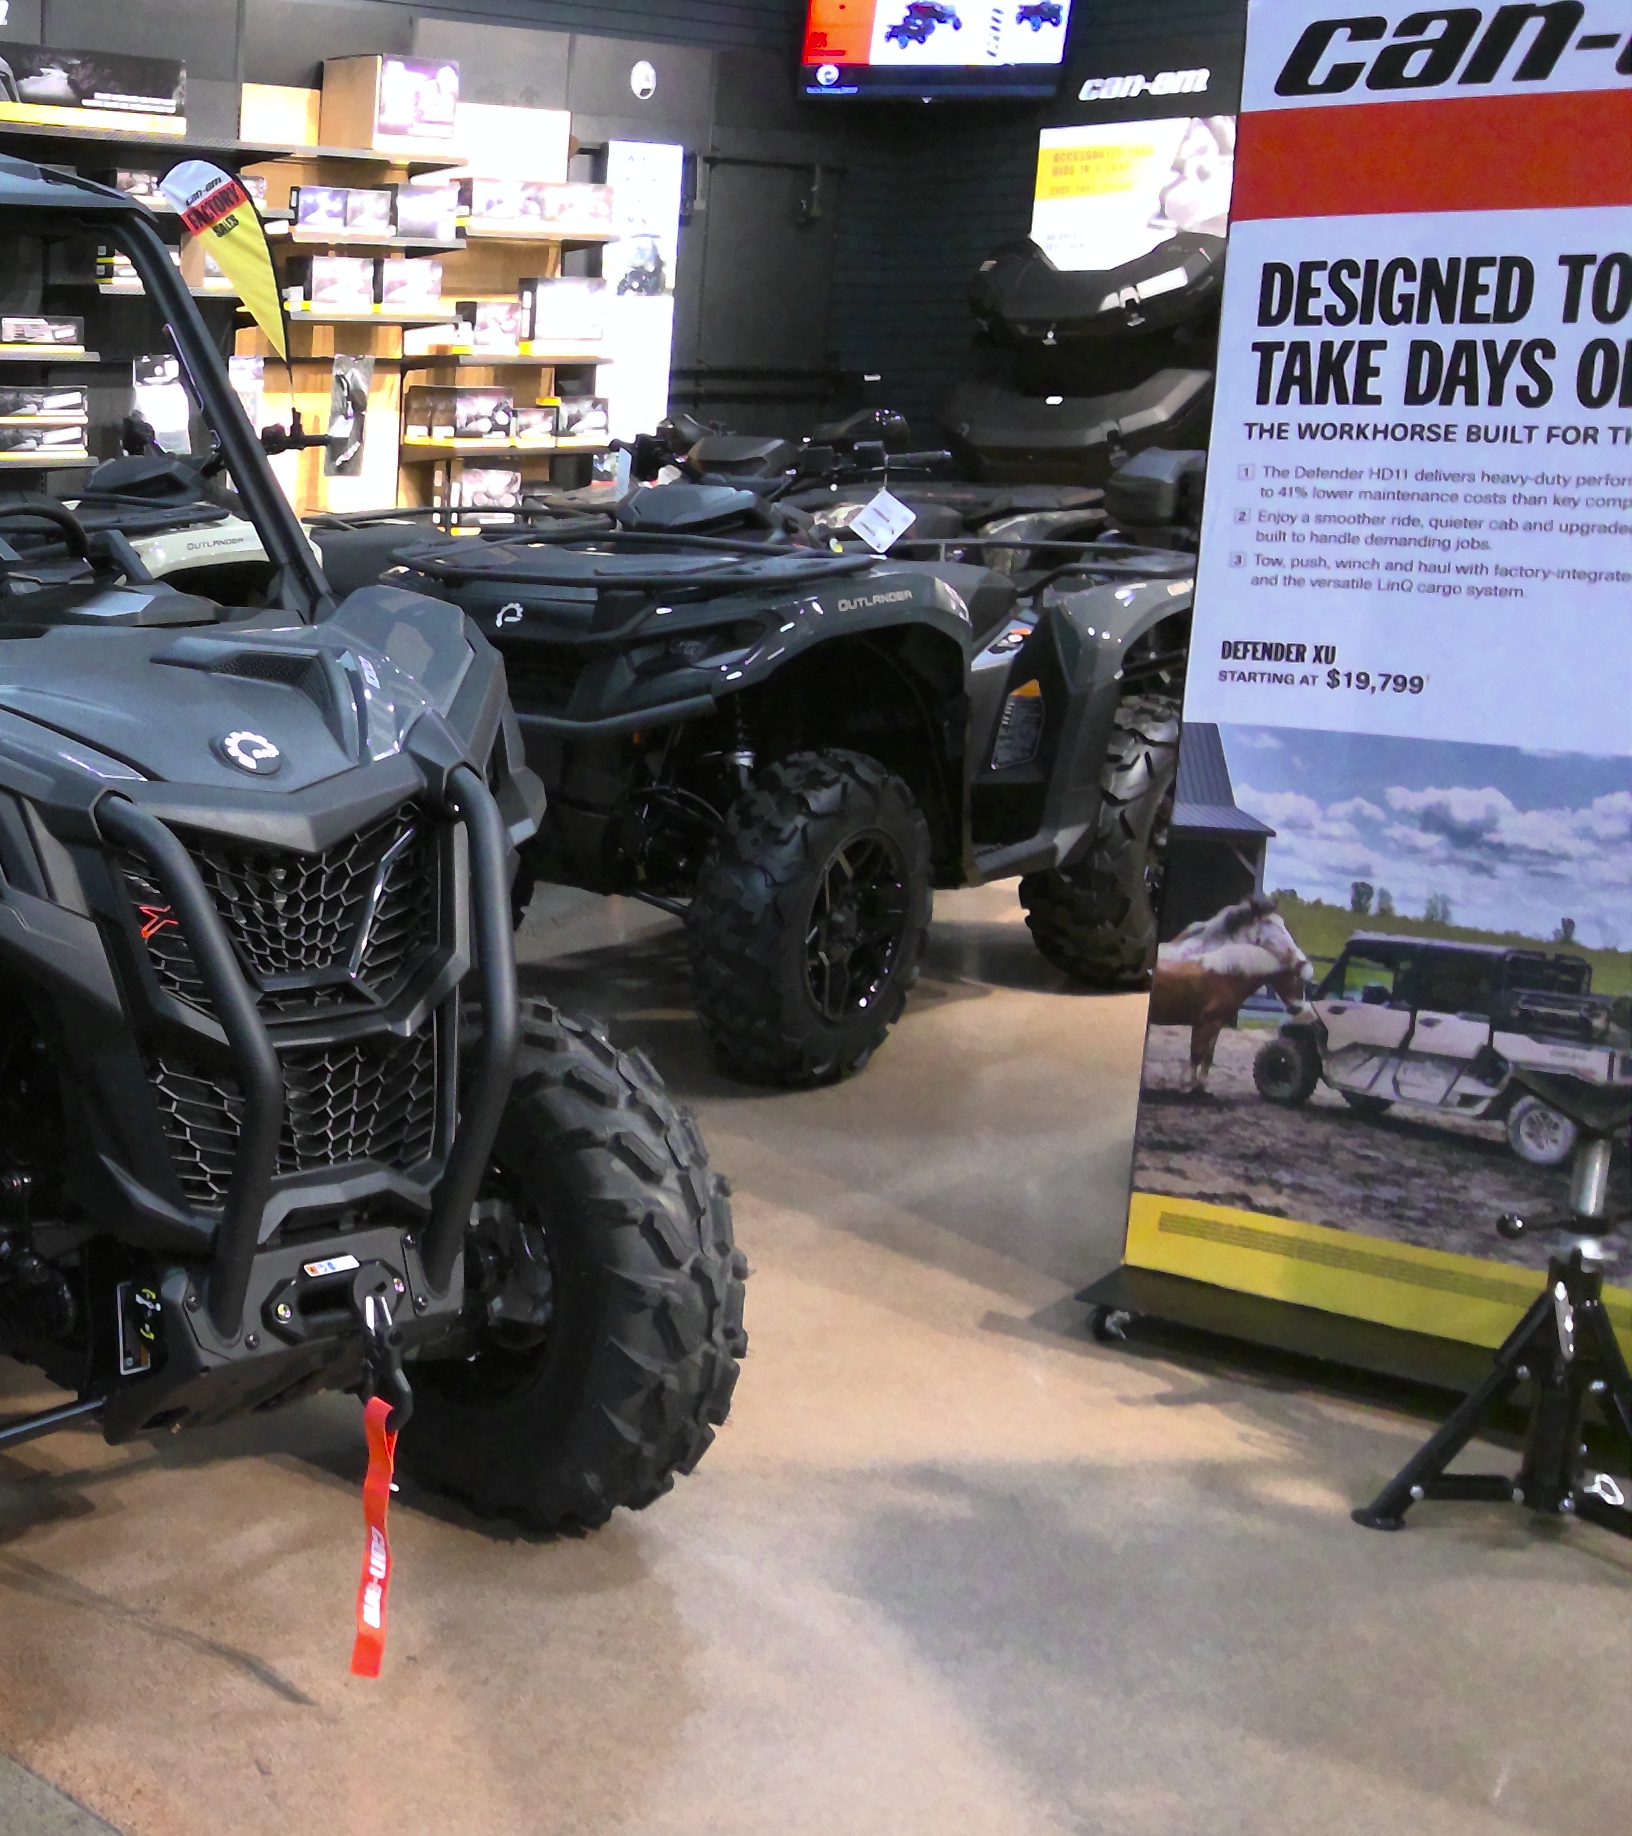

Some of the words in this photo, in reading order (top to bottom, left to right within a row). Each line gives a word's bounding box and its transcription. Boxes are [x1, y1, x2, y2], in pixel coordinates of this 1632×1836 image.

[1274, 1, 1632, 96] can-
[1079, 67, 1210, 102] can-am
[187, 183, 241, 231] FACTORY
[1257, 255, 1535, 327] DESIGNED
[1558, 252, 1632, 325] TO
[1251, 339, 1388, 406] TAKE
[1403, 337, 1556, 409] DAYS
[1244, 422, 1290, 441] THE
[1298, 423, 1458, 443] WORKHORSE
[1465, 424, 1539, 445] BUILT
[1546, 425, 1600, 446] FOR
[1263, 465, 1290, 479] The
[1294, 466, 1364, 480] Defender
[1368, 467, 1409, 480] HD11
[1414, 469, 1476, 482] delivers
[1480, 471, 1572, 487] heavy-duty
[1575, 472, 1632, 488] perfor
[1260, 486, 1274, 498] to
[1278, 486, 1308, 498] 41%
[1312, 486, 1354, 499] lower
[1358, 488, 1459, 503] maintenance
[1463, 492, 1507, 505] costs
[1512, 492, 1548, 506] than
[1552, 494, 1581, 510] key
[1257, 510, 1298, 526] Enjoy
[1301, 513, 1310, 524] a
[1314, 513, 1387, 525] smoother
[1391, 515, 1424, 529] ride,
[1428, 515, 1485, 530] quieter
[1488, 518, 1519, 531] cab
[1522, 519, 1554, 532] and
[1558, 520, 1632, 537] upgrade
[187, 537, 244, 551] OUTLANDER
[1255, 530, 1287, 542] built
[1291, 531, 1306, 543] to
[1309, 531, 1361, 545] handle
[1364, 533, 1451, 552] demanding
[1254, 553, 1285, 568] Tow,
[1290, 555, 1331, 570] push,
[1335, 557, 1380, 571] winch
[1384, 560, 1414, 573] and
[1418, 560, 1451, 574] haul
[1455, 562, 1489, 576] with
[1250, 574, 1279, 587] and
[1283, 574, 1306, 588] the
[1310, 577, 1373, 591] versatile
[1377, 578, 1414, 593] LinQ
[1416, 582, 1462, 597] cargo
[837, 589, 914, 612] OUTLANDER
[1221, 640, 1307, 663] DEFENDER
[1312, 644, 1337, 665] XU
[1218, 669, 1295, 686] STARTING
[1299, 674, 1320, 686] AT
[363, 1525, 387, 1629] can-am
